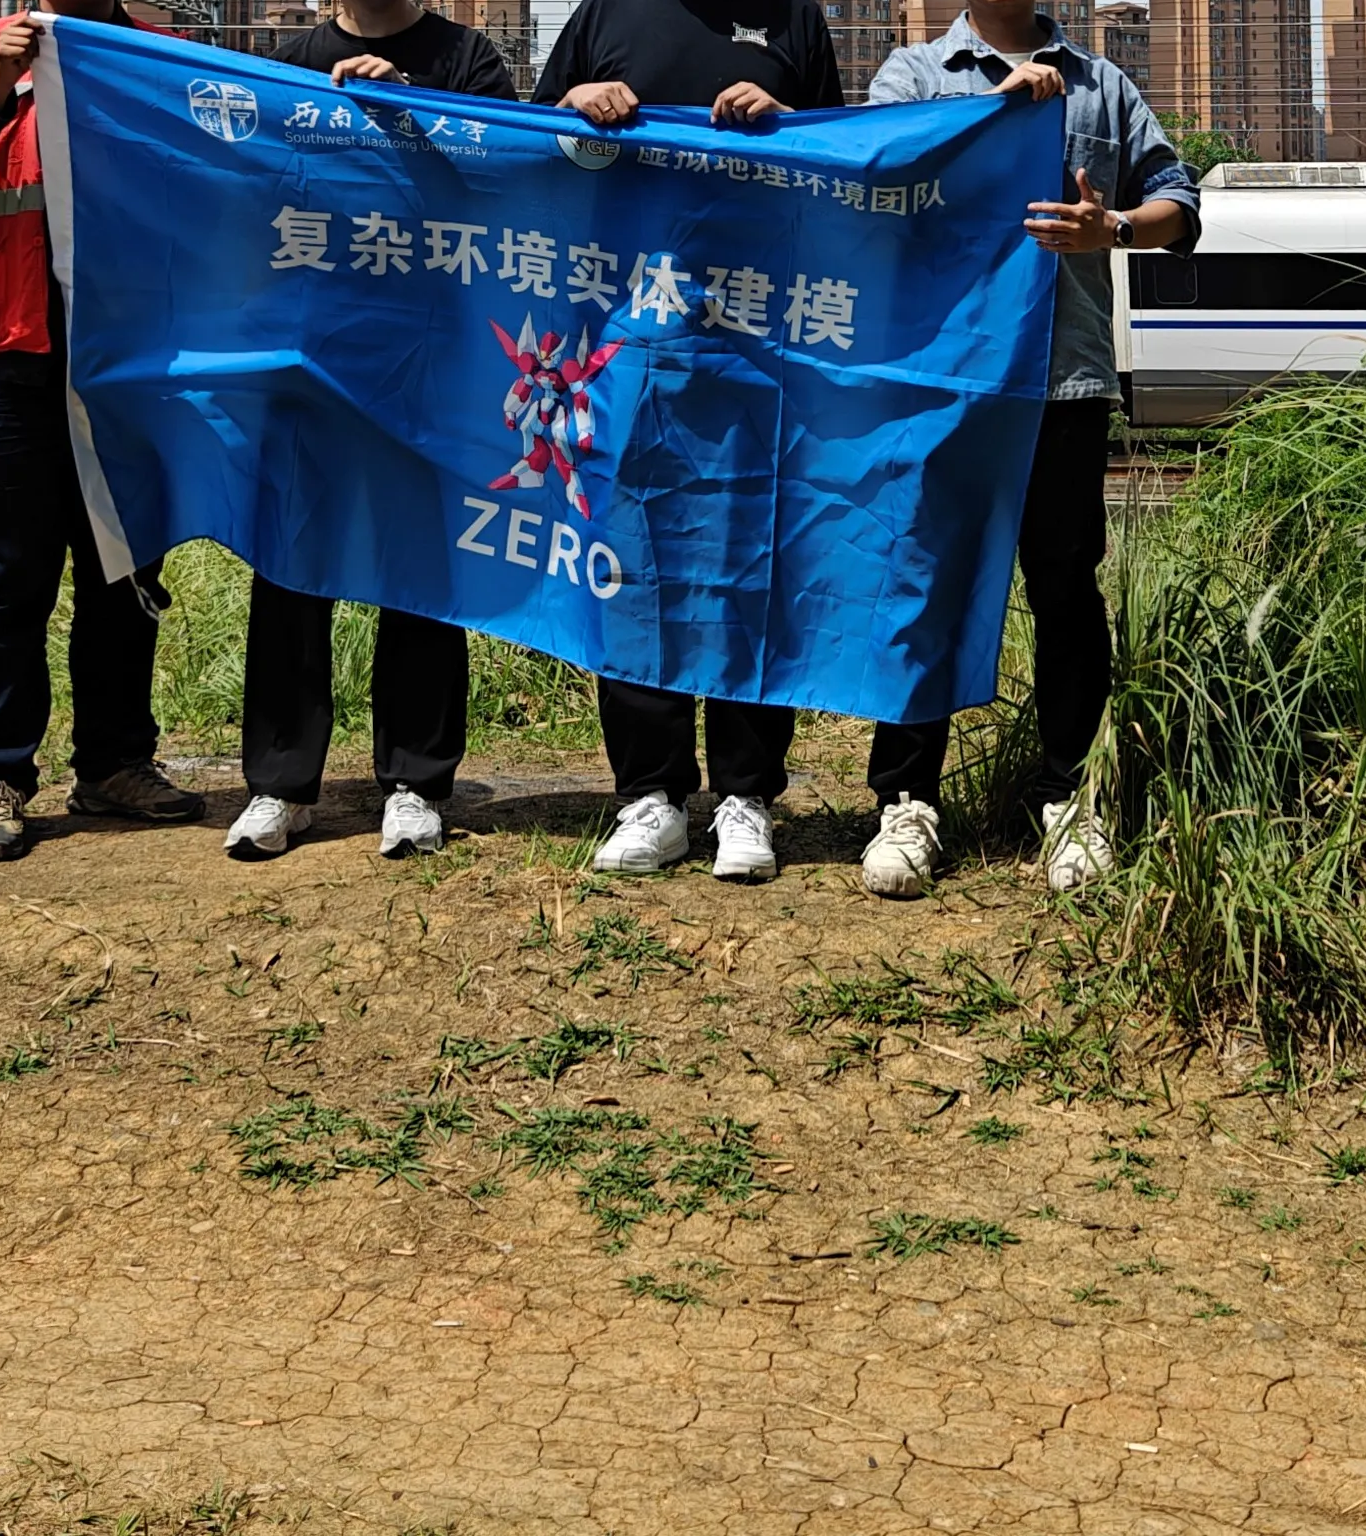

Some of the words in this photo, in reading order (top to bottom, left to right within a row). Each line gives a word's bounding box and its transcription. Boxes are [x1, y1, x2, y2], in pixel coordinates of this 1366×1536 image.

[284, 131, 357, 146] Southwest
[360, 135, 418, 152] Jiaotong
[421, 137, 488, 159] University
[269, 205, 860, 351] 复杂环境实体建模
[455, 495, 623, 600] ZERO
